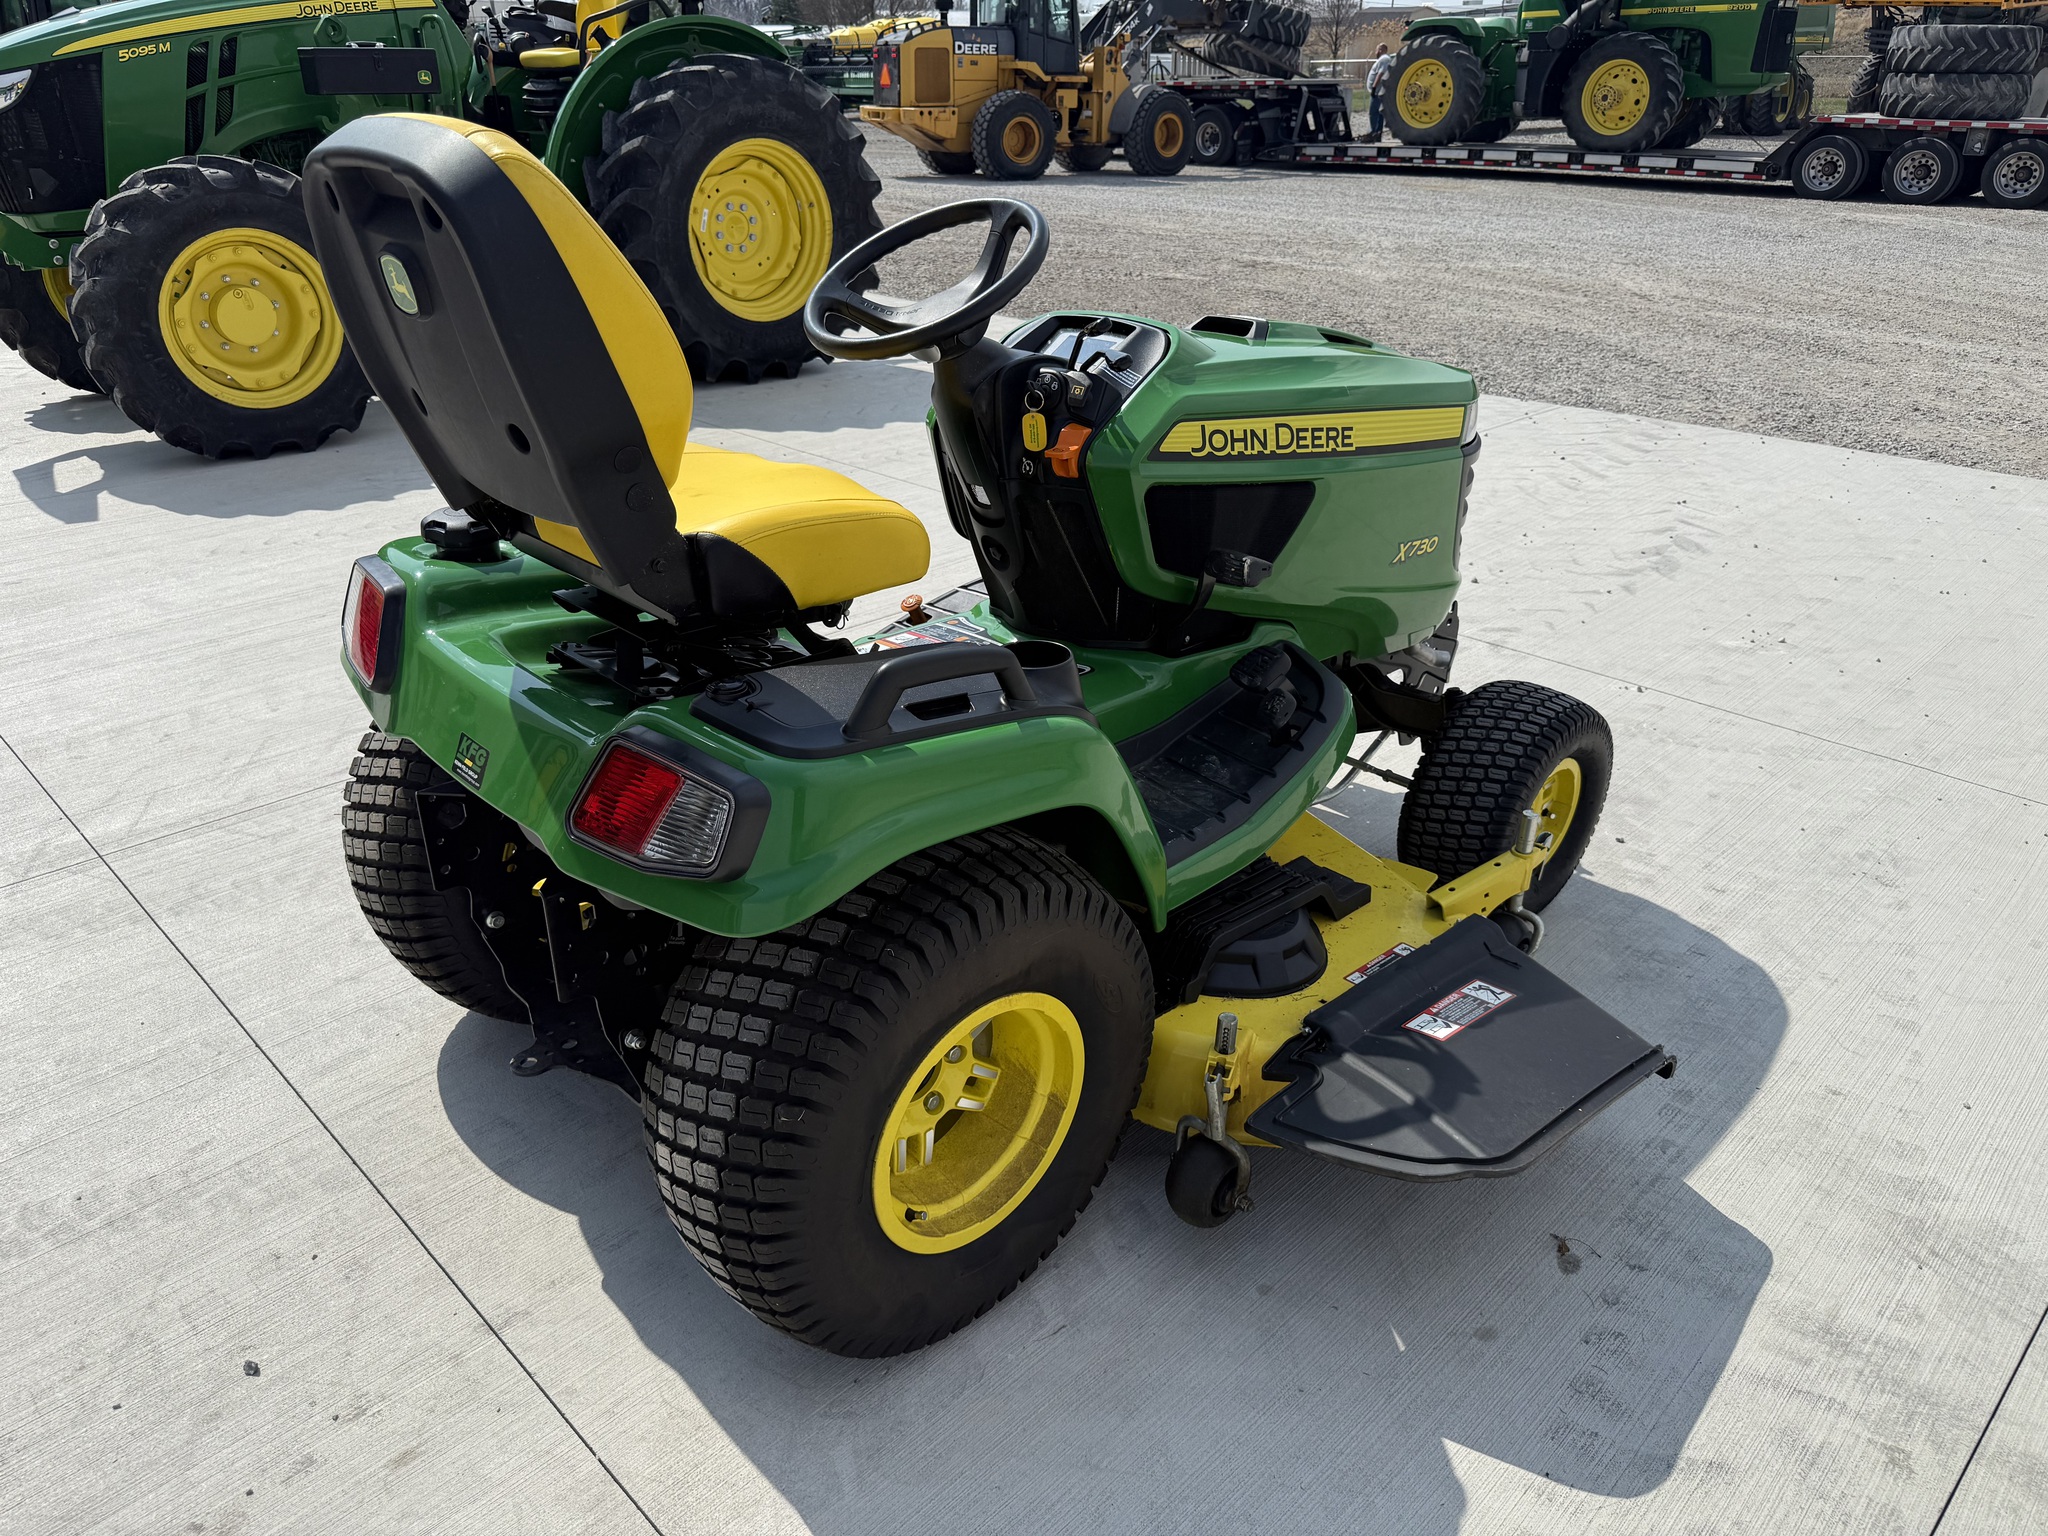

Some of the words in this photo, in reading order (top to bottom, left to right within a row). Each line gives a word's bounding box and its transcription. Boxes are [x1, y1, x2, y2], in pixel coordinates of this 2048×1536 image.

[296, 3, 333, 17] JOHN
[334, 1, 379, 14] DEERE
[1727, 3, 1752, 11] 9200
[118, 44, 157, 62] 5095
[159, 41, 172, 54] M
[954, 41, 998, 55] DEERE
[1190, 424, 1268, 453] JOHN
[1274, 422, 1355, 451] DEERE
[1391, 535, 1440, 565] X730
[459, 736, 487, 767] KFG
[1434, 992, 1461, 1010] DANGER
